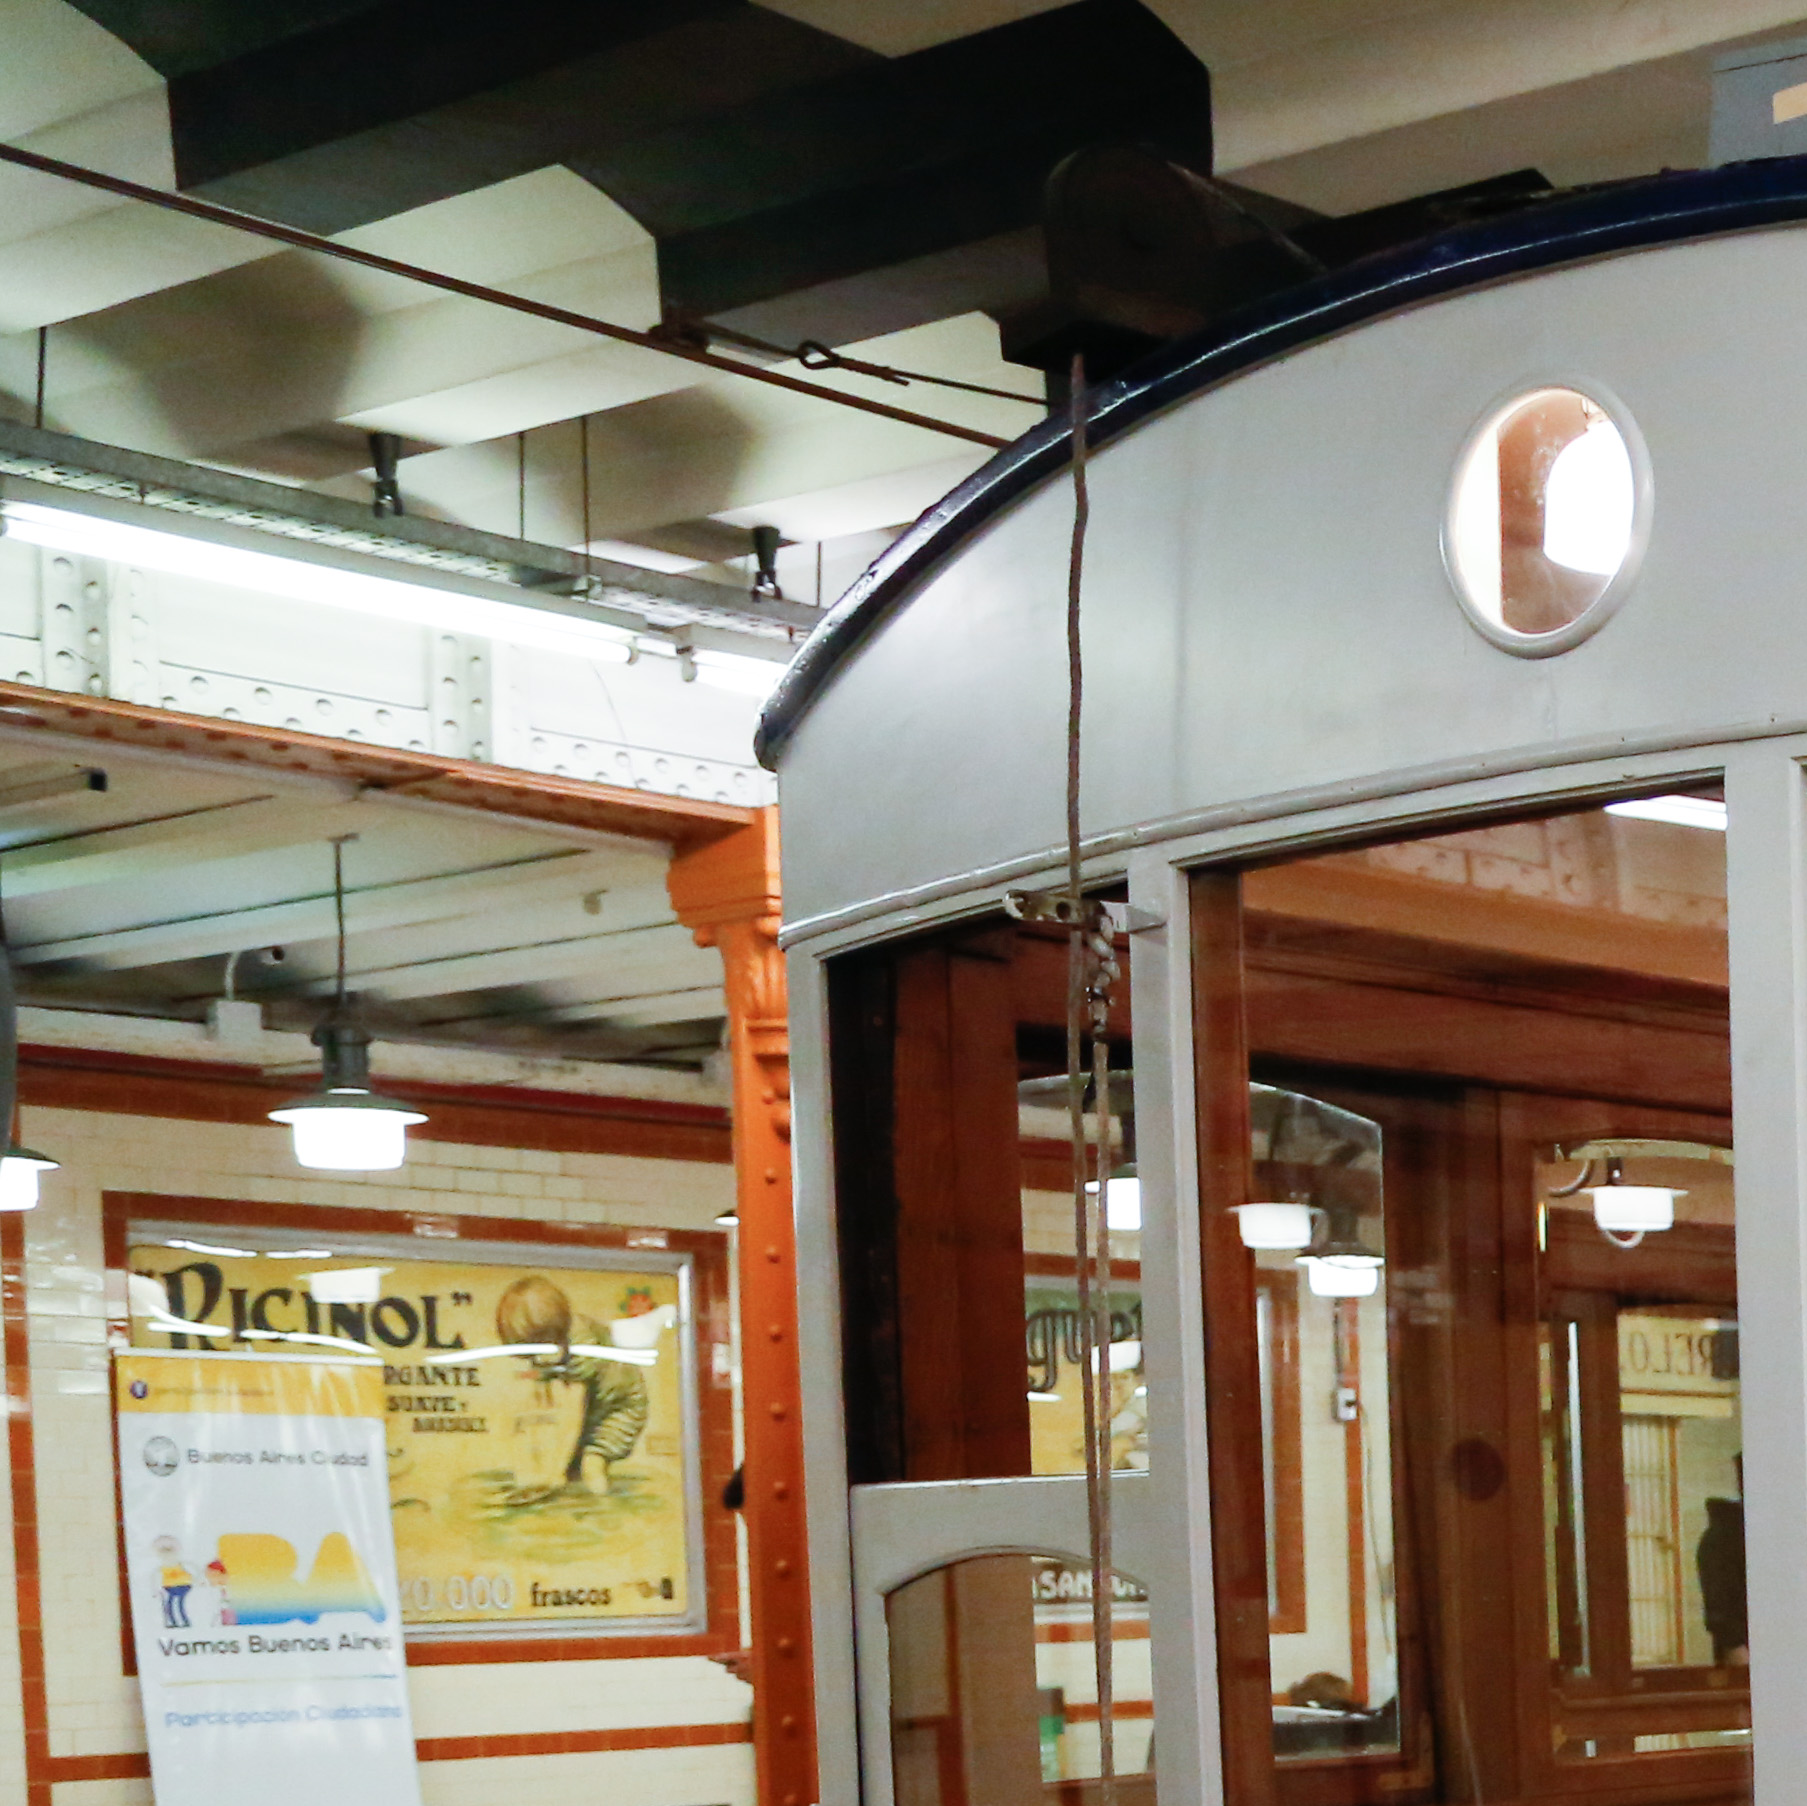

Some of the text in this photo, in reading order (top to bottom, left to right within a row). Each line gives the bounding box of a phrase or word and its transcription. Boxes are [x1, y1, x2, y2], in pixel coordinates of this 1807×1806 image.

[383, 1366, 481, 1386] RGANTE
[158, 1633, 392, 1657] Vamos Buenos Aires
